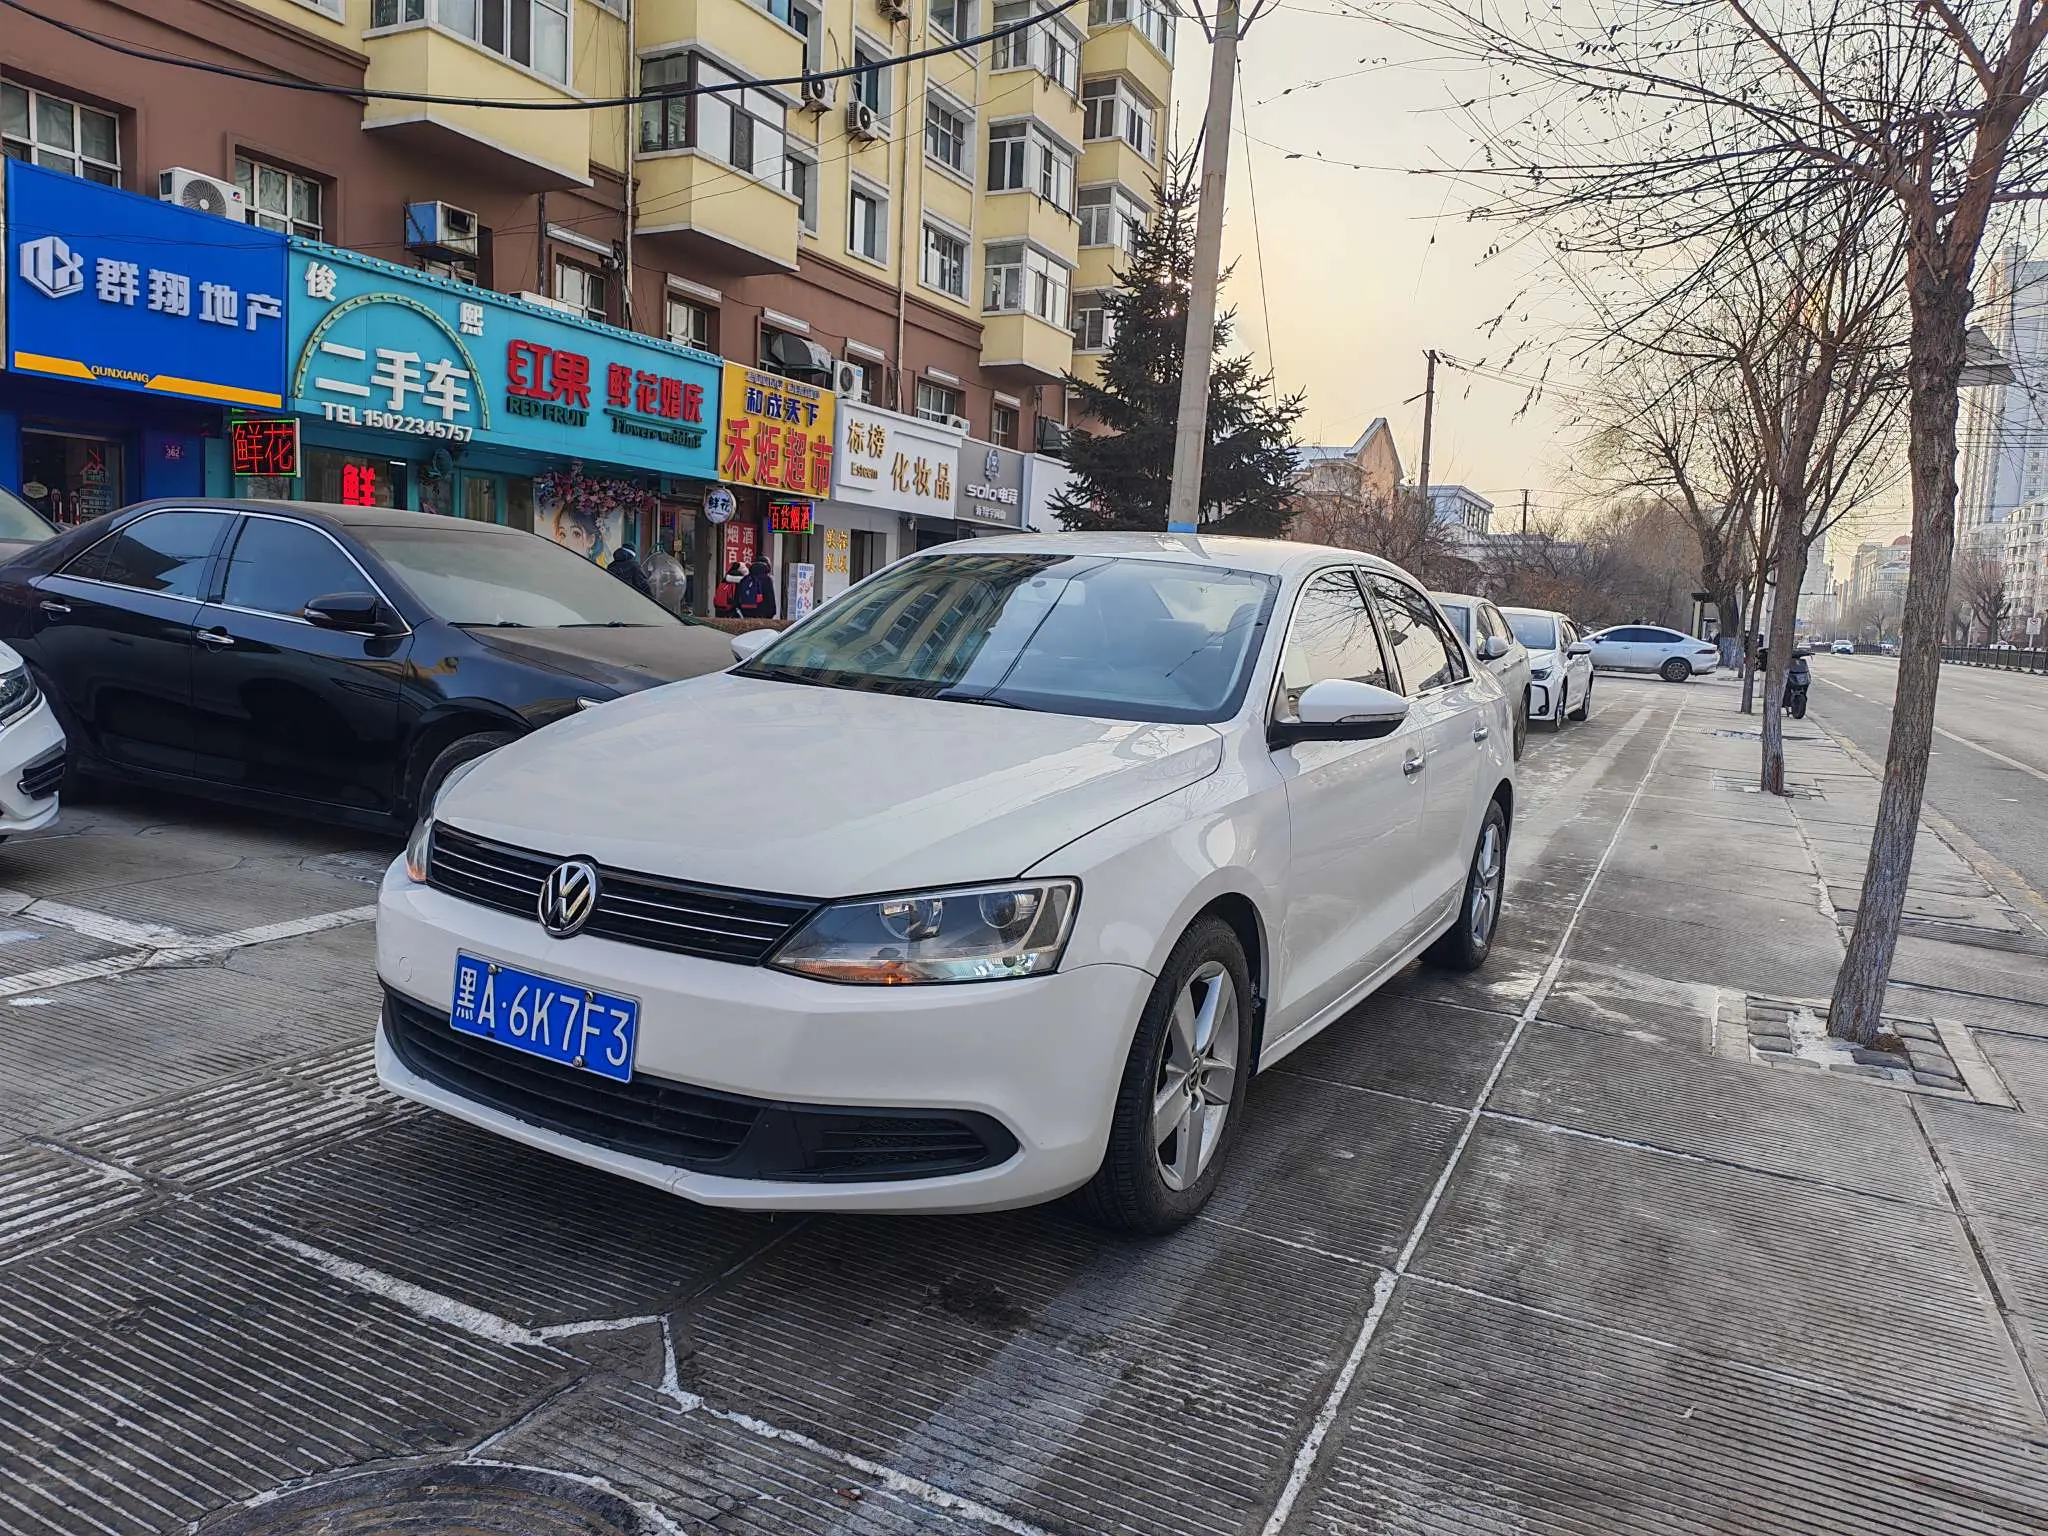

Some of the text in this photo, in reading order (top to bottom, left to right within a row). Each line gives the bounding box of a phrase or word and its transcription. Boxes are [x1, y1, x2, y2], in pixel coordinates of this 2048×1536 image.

[96, 257, 282, 331] 群翔地产
[304, 261, 484, 336] 俊 熙
[91, 364, 149, 384] QUNXIANG
[315, 341, 470, 421] 二手车
[507, 339, 591, 409] 红果
[606, 362, 705, 424] 鲜花婚庆
[321, 401, 473, 443] TEL 15022345757
[507, 396, 590, 428] RED FRUIT
[746, 386, 820, 428] 和成天下
[235, 424, 293, 473] 鲜花
[847, 417, 886, 459] 标榜
[891, 450, 951, 502] 化妆品
[708, 496, 731, 513] 鲜花
[768, 503, 810, 531] 百货烟酒
[727, 525, 754, 545] 烟酒
